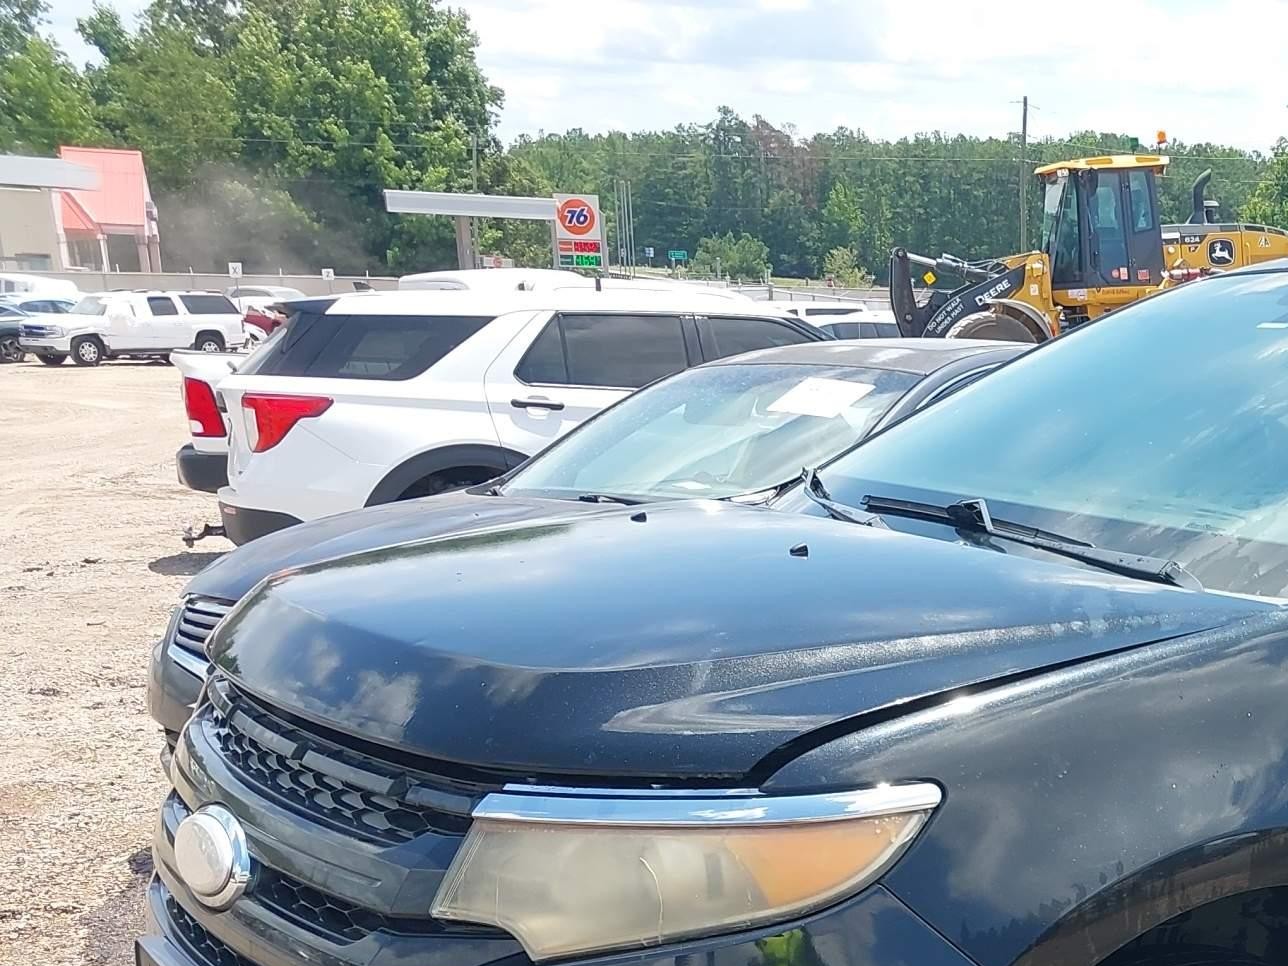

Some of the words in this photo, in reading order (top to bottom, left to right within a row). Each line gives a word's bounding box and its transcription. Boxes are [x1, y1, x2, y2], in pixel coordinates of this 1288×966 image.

[565, 207, 589, 226] 76
[975, 279, 1011, 306] DEERE
[928, 322, 937, 331] DO
[936, 311, 948, 322] NOT
[947, 298, 962, 312] WALK
[935, 316, 952, 334] UNDER
